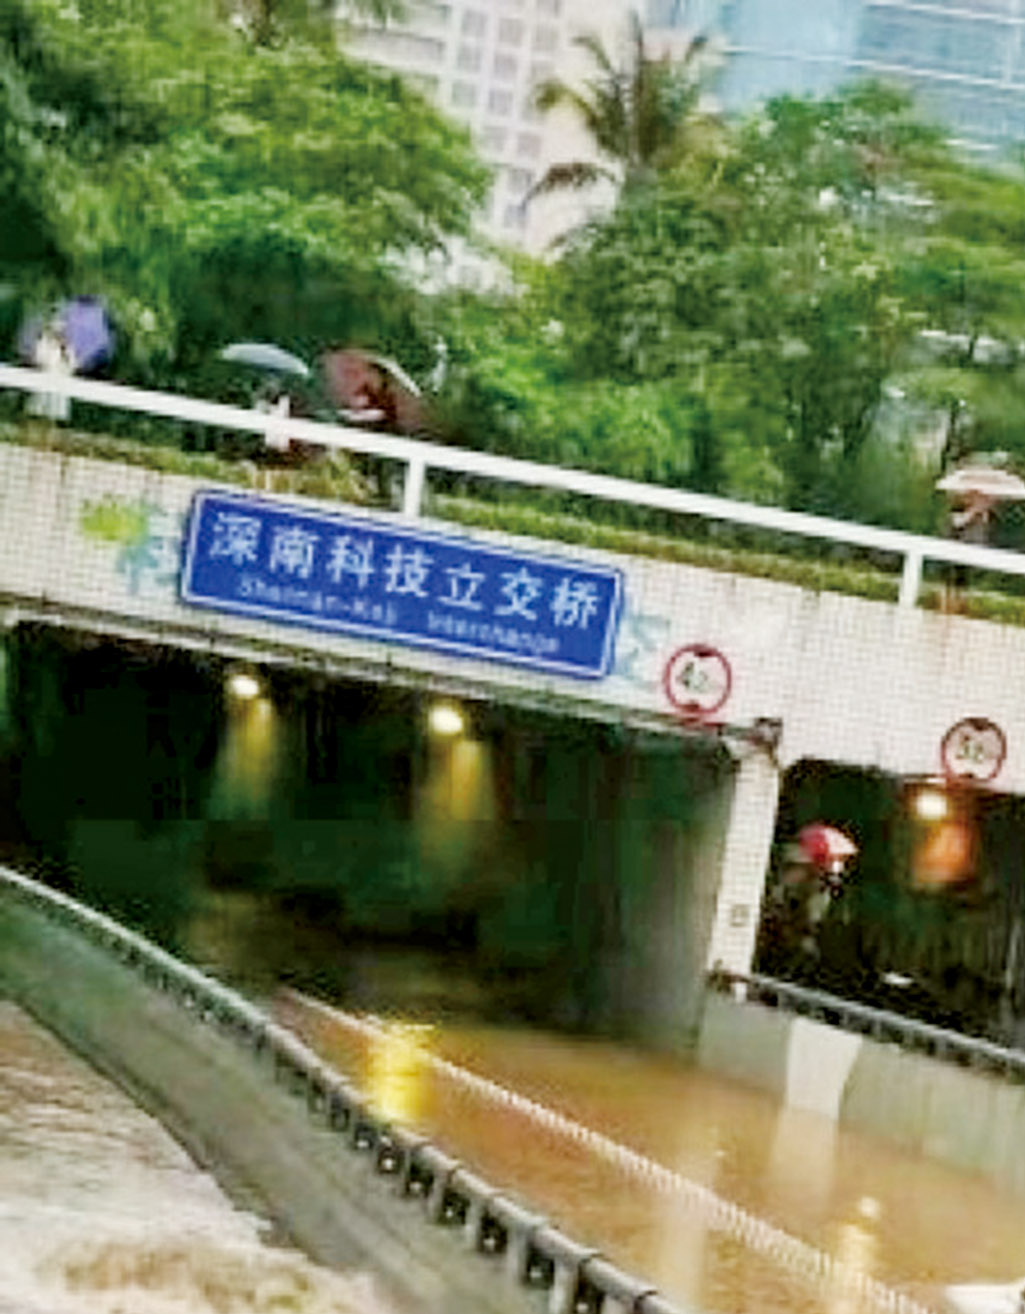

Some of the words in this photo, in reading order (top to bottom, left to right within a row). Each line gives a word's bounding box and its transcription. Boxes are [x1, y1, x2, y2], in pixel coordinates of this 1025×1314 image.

[209, 511, 600, 629] 深南科技立交桥
